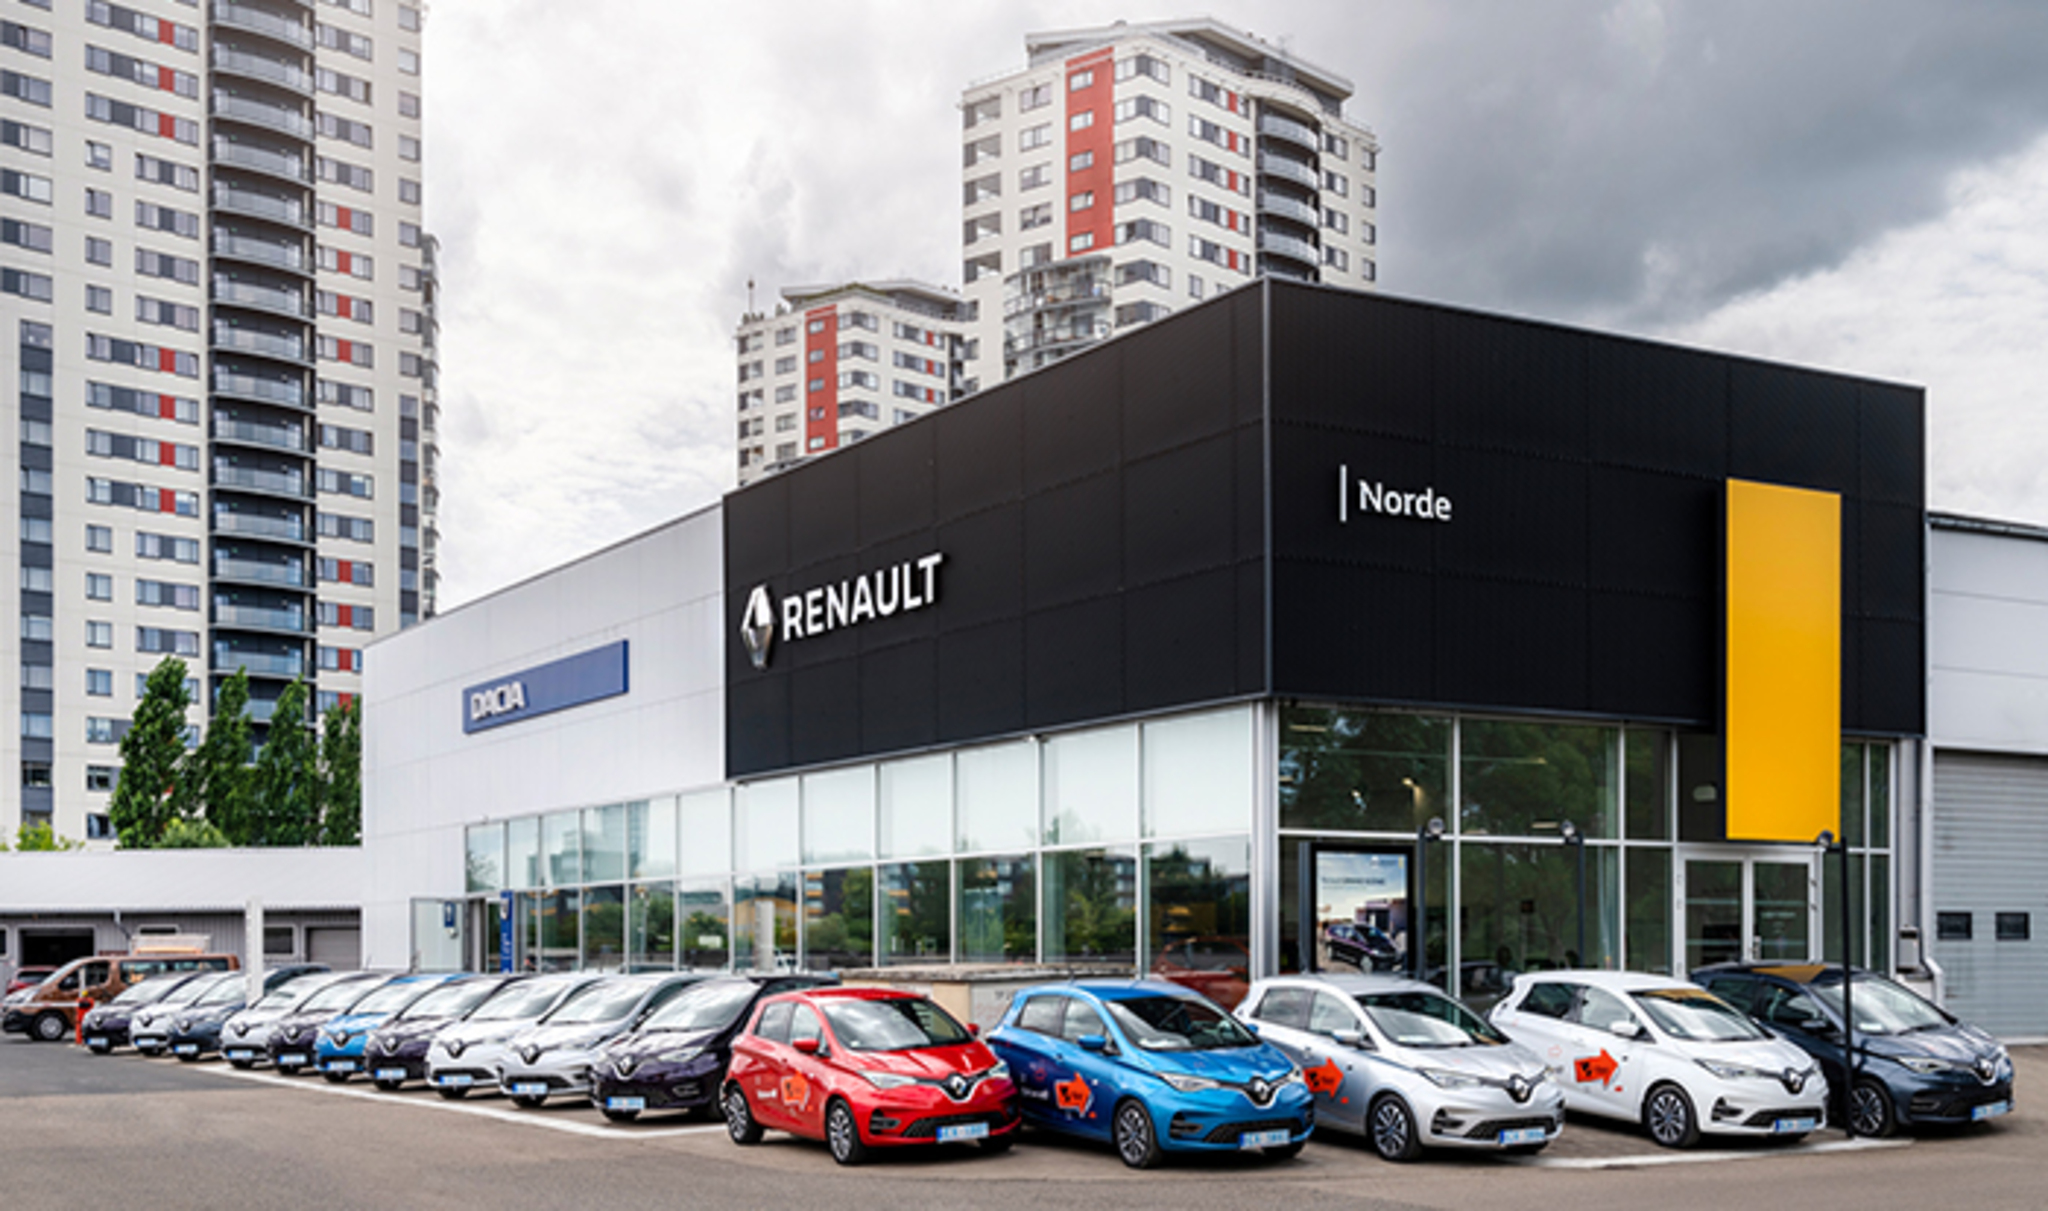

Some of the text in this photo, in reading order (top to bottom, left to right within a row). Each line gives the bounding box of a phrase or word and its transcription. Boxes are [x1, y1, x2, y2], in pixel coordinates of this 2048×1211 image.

[1358, 479, 1452, 522] Norde
[782, 552, 943, 642] RENAULT
[470, 681, 526, 721] DACIA
